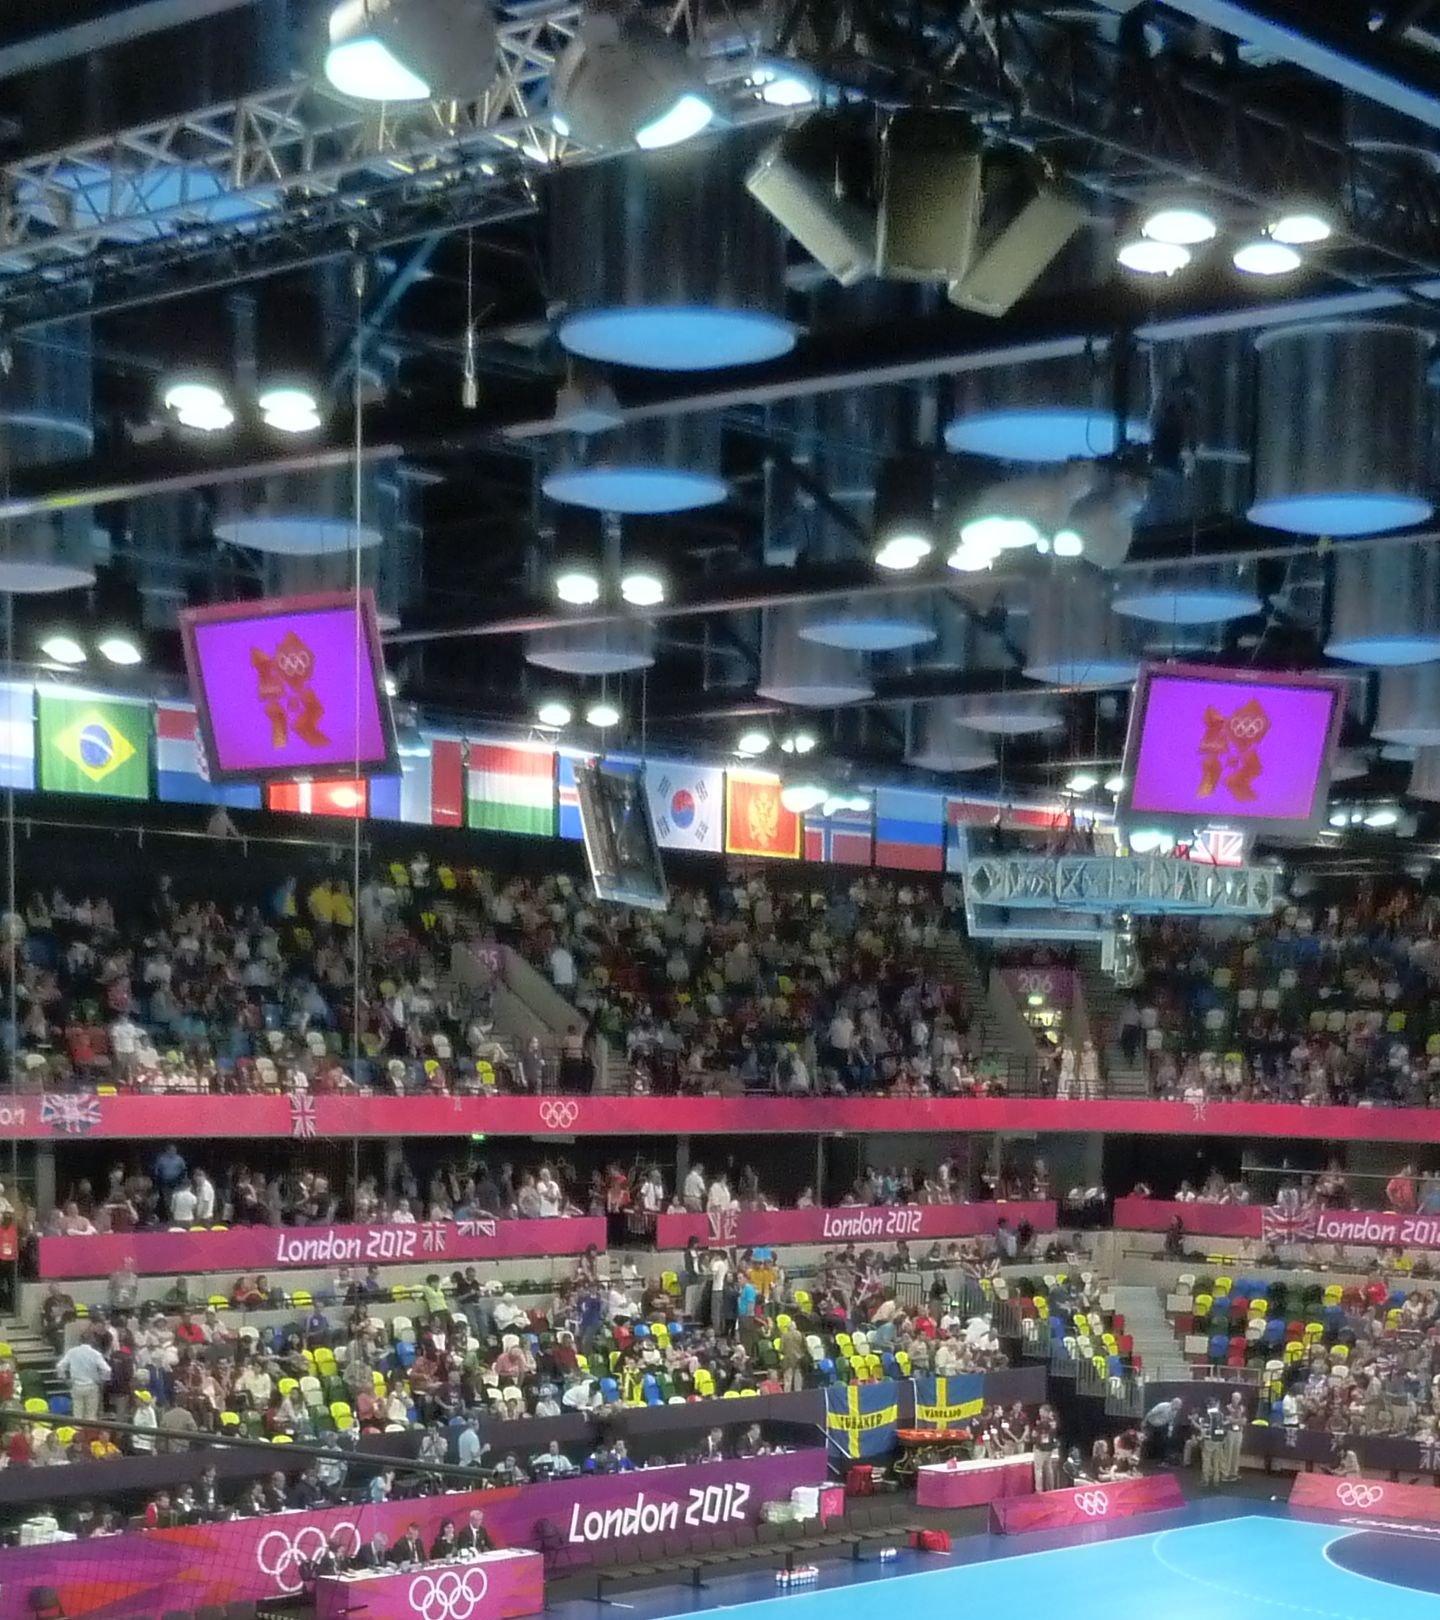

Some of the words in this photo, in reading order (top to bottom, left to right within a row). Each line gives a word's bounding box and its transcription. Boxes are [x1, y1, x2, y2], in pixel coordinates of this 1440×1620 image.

[1017, 973, 1053, 993] 206
[823, 1210, 884, 1237] London
[885, 1210, 922, 1234] 2012
[1315, 1214, 1396, 1243] London
[276, 1230, 362, 1262] London
[365, 1229, 417, 1258] 2012
[569, 1491, 679, 1543] London
[685, 1482, 750, 1527] 2012
